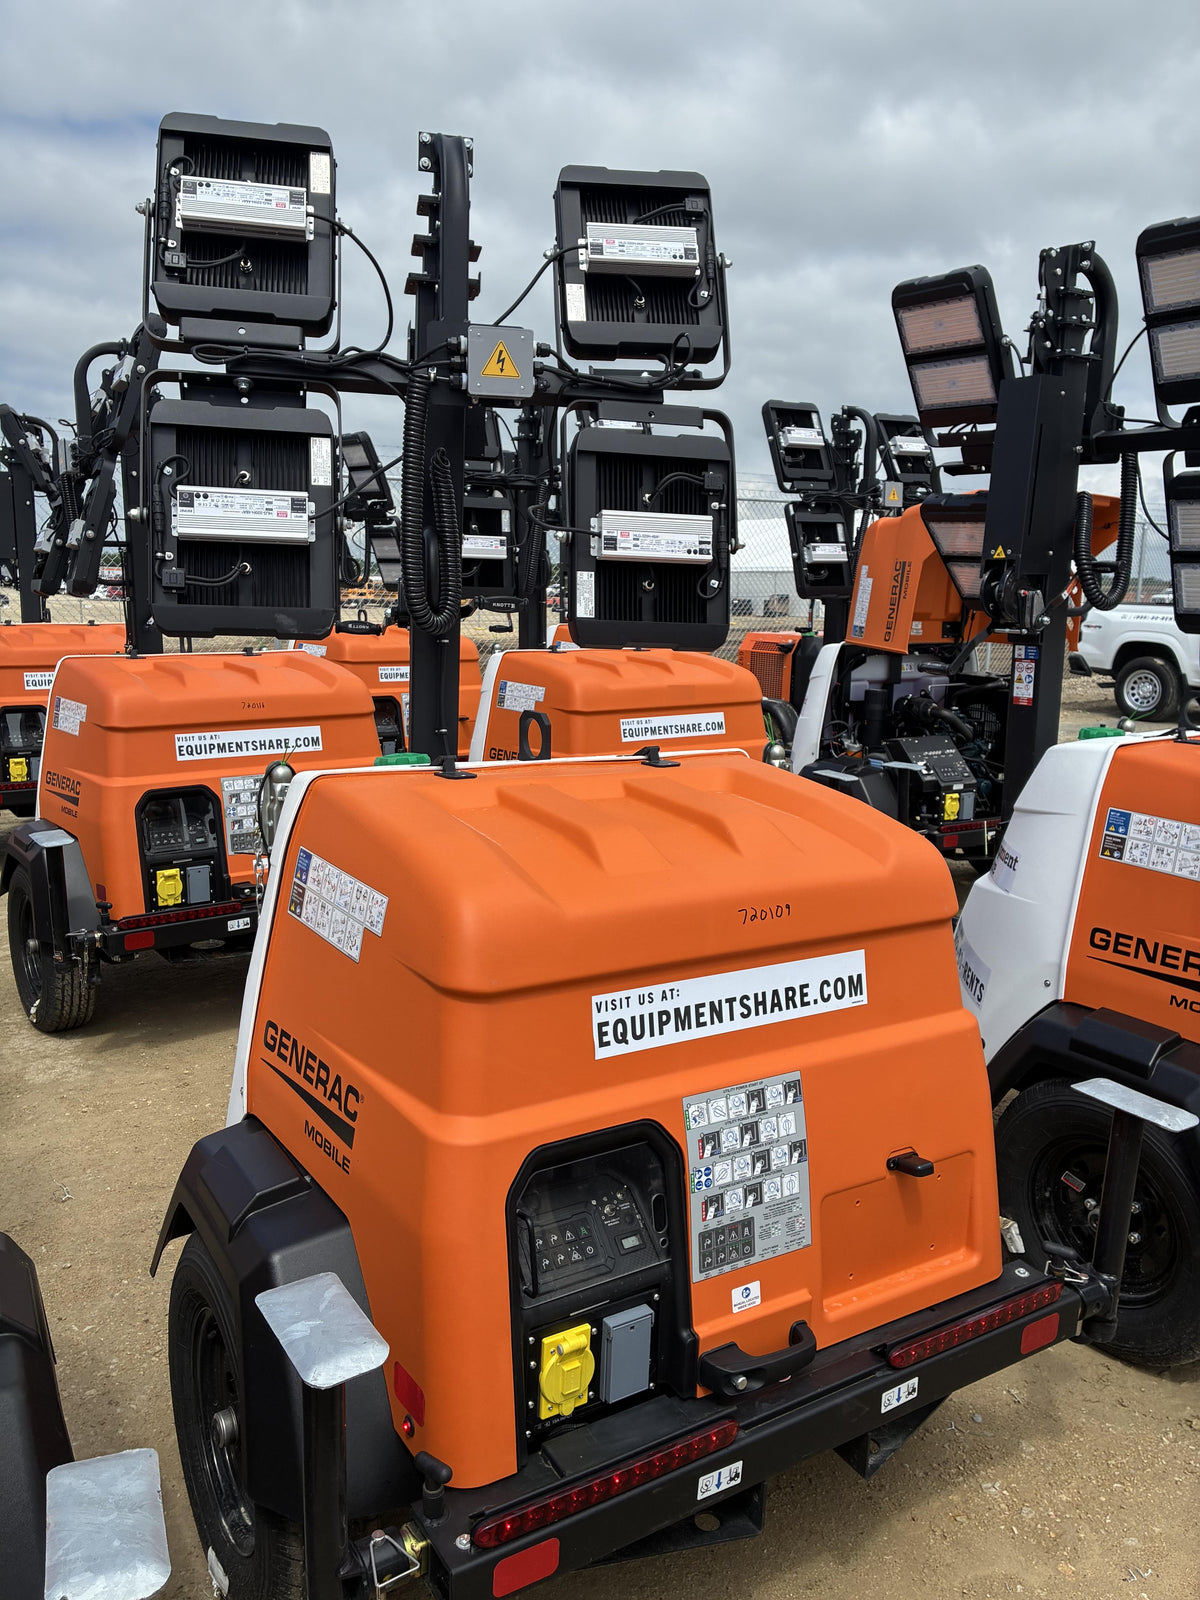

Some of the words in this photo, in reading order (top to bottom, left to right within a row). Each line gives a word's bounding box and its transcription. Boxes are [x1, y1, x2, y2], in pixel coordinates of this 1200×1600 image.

[884, 560, 902, 642] GENERAC
[622, 721, 724, 738] EQUIPMENTSHARE.COM
[178, 736, 320, 756] EQUIPMENTSHARE.COM
[46, 771, 81, 796] GENERAC
[61, 805, 78, 818] MOBILE
[738, 904, 790, 924] 720109
[596, 996, 631, 1014] VISIT
[638, 992, 654, 1006] US
[661, 988, 680, 1002] AT:
[597, 973, 864, 1048] EQUIPMENTSHARE.COM
[264, 1020, 360, 1122] GENERAC
[305, 1120, 350, 1175] MOBILE
